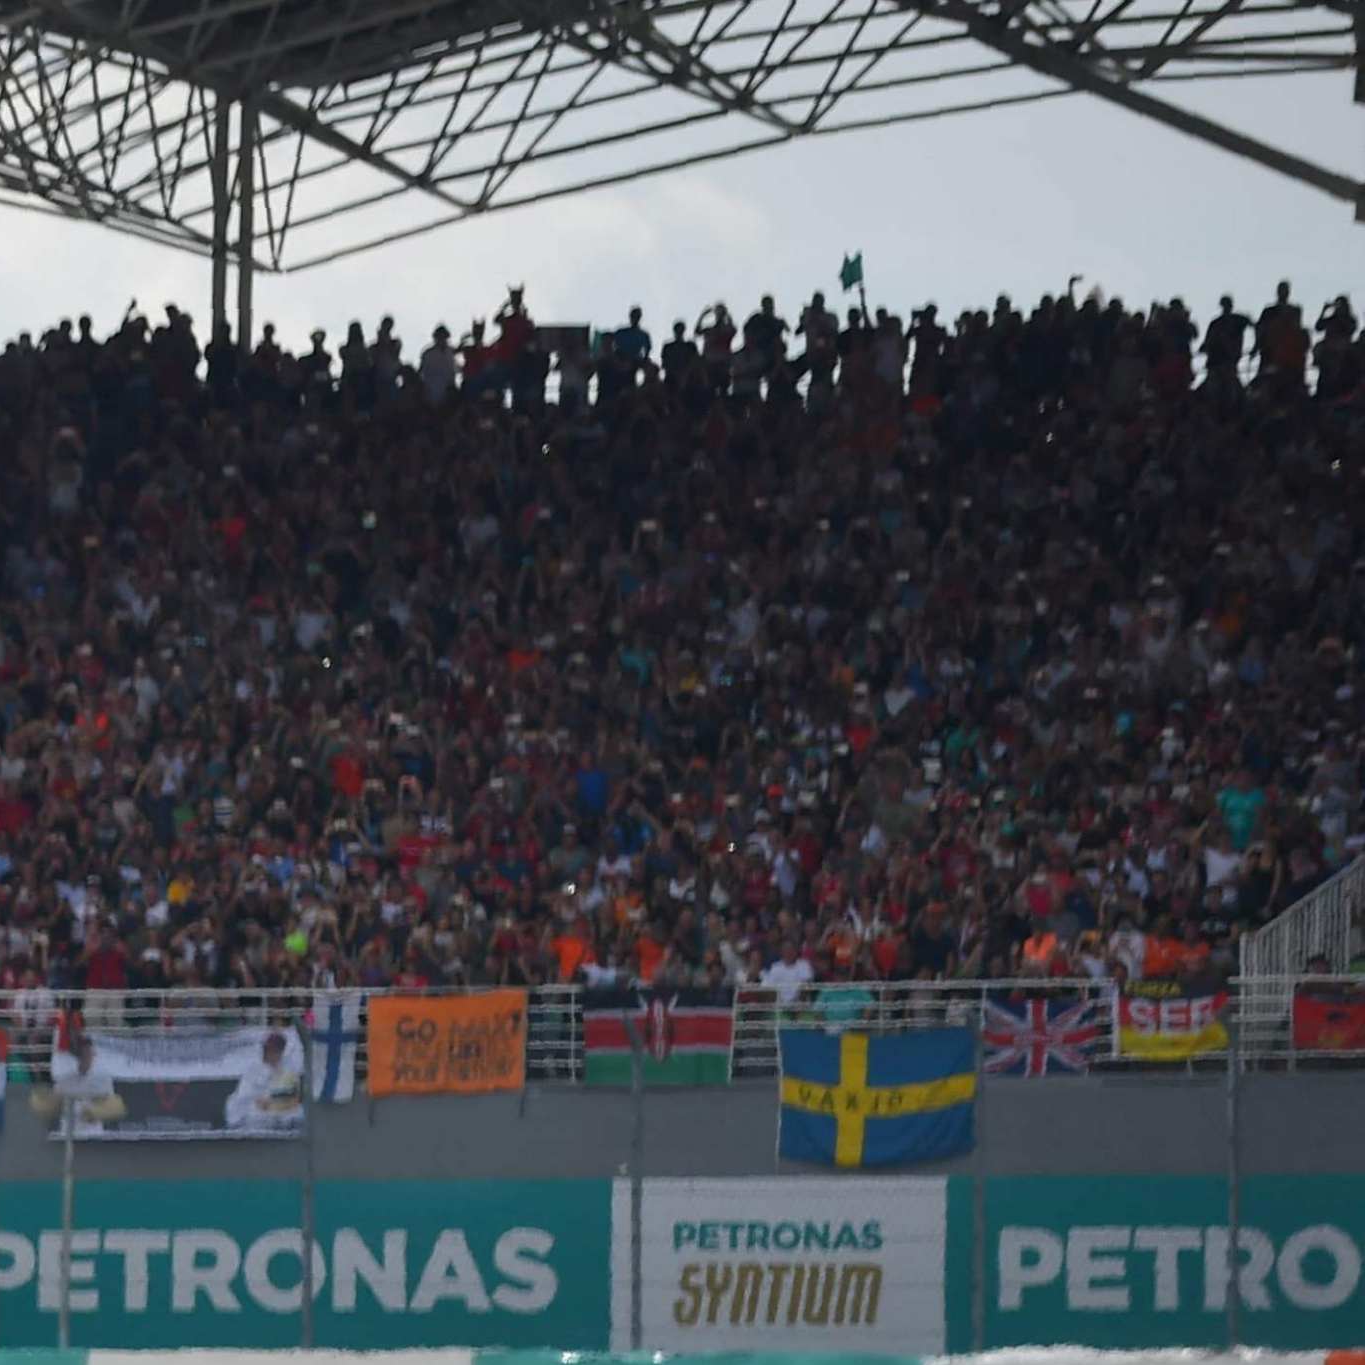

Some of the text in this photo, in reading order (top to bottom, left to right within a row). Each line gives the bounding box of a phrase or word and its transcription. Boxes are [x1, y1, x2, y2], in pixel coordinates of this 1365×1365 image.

[672, 1220, 884, 1251] PETRONAS
[998, 1225, 1361, 1312] PETRO
[672, 1261, 884, 1328] SYNTIUM
